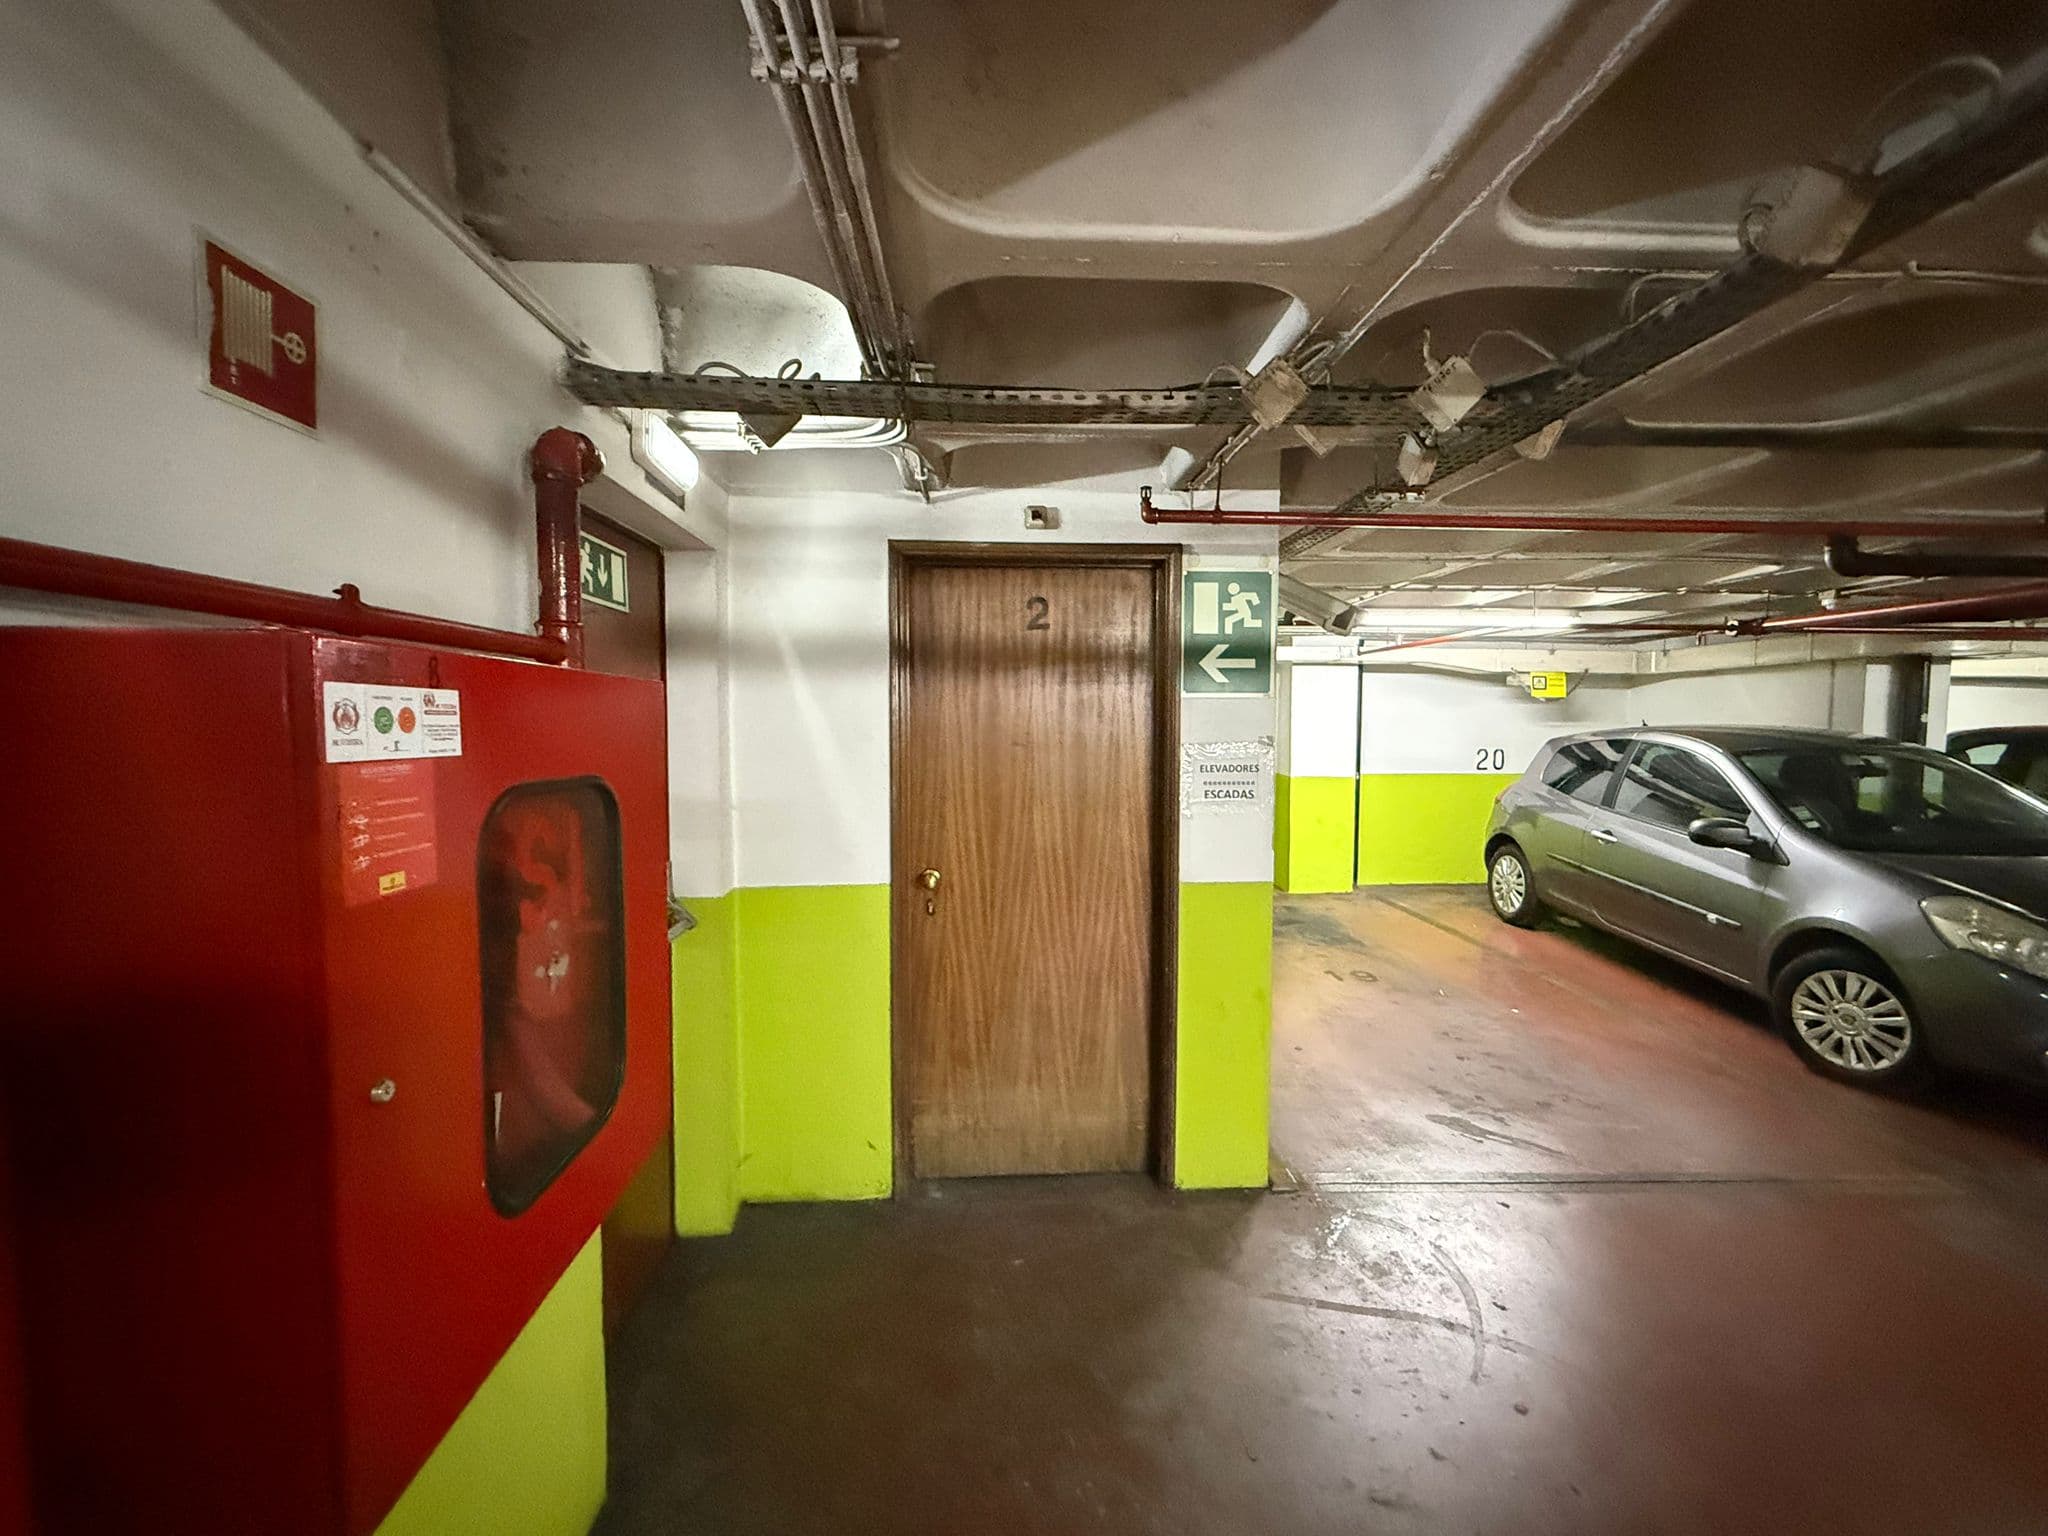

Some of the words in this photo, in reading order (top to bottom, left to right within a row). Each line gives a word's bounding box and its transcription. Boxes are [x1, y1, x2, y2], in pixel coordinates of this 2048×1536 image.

[1026, 596, 1050, 631] 2
[1476, 748, 1505, 771] 20
[1200, 764, 1260, 773] ELEVADORES
[1204, 789, 1255, 799] ESCADAS
